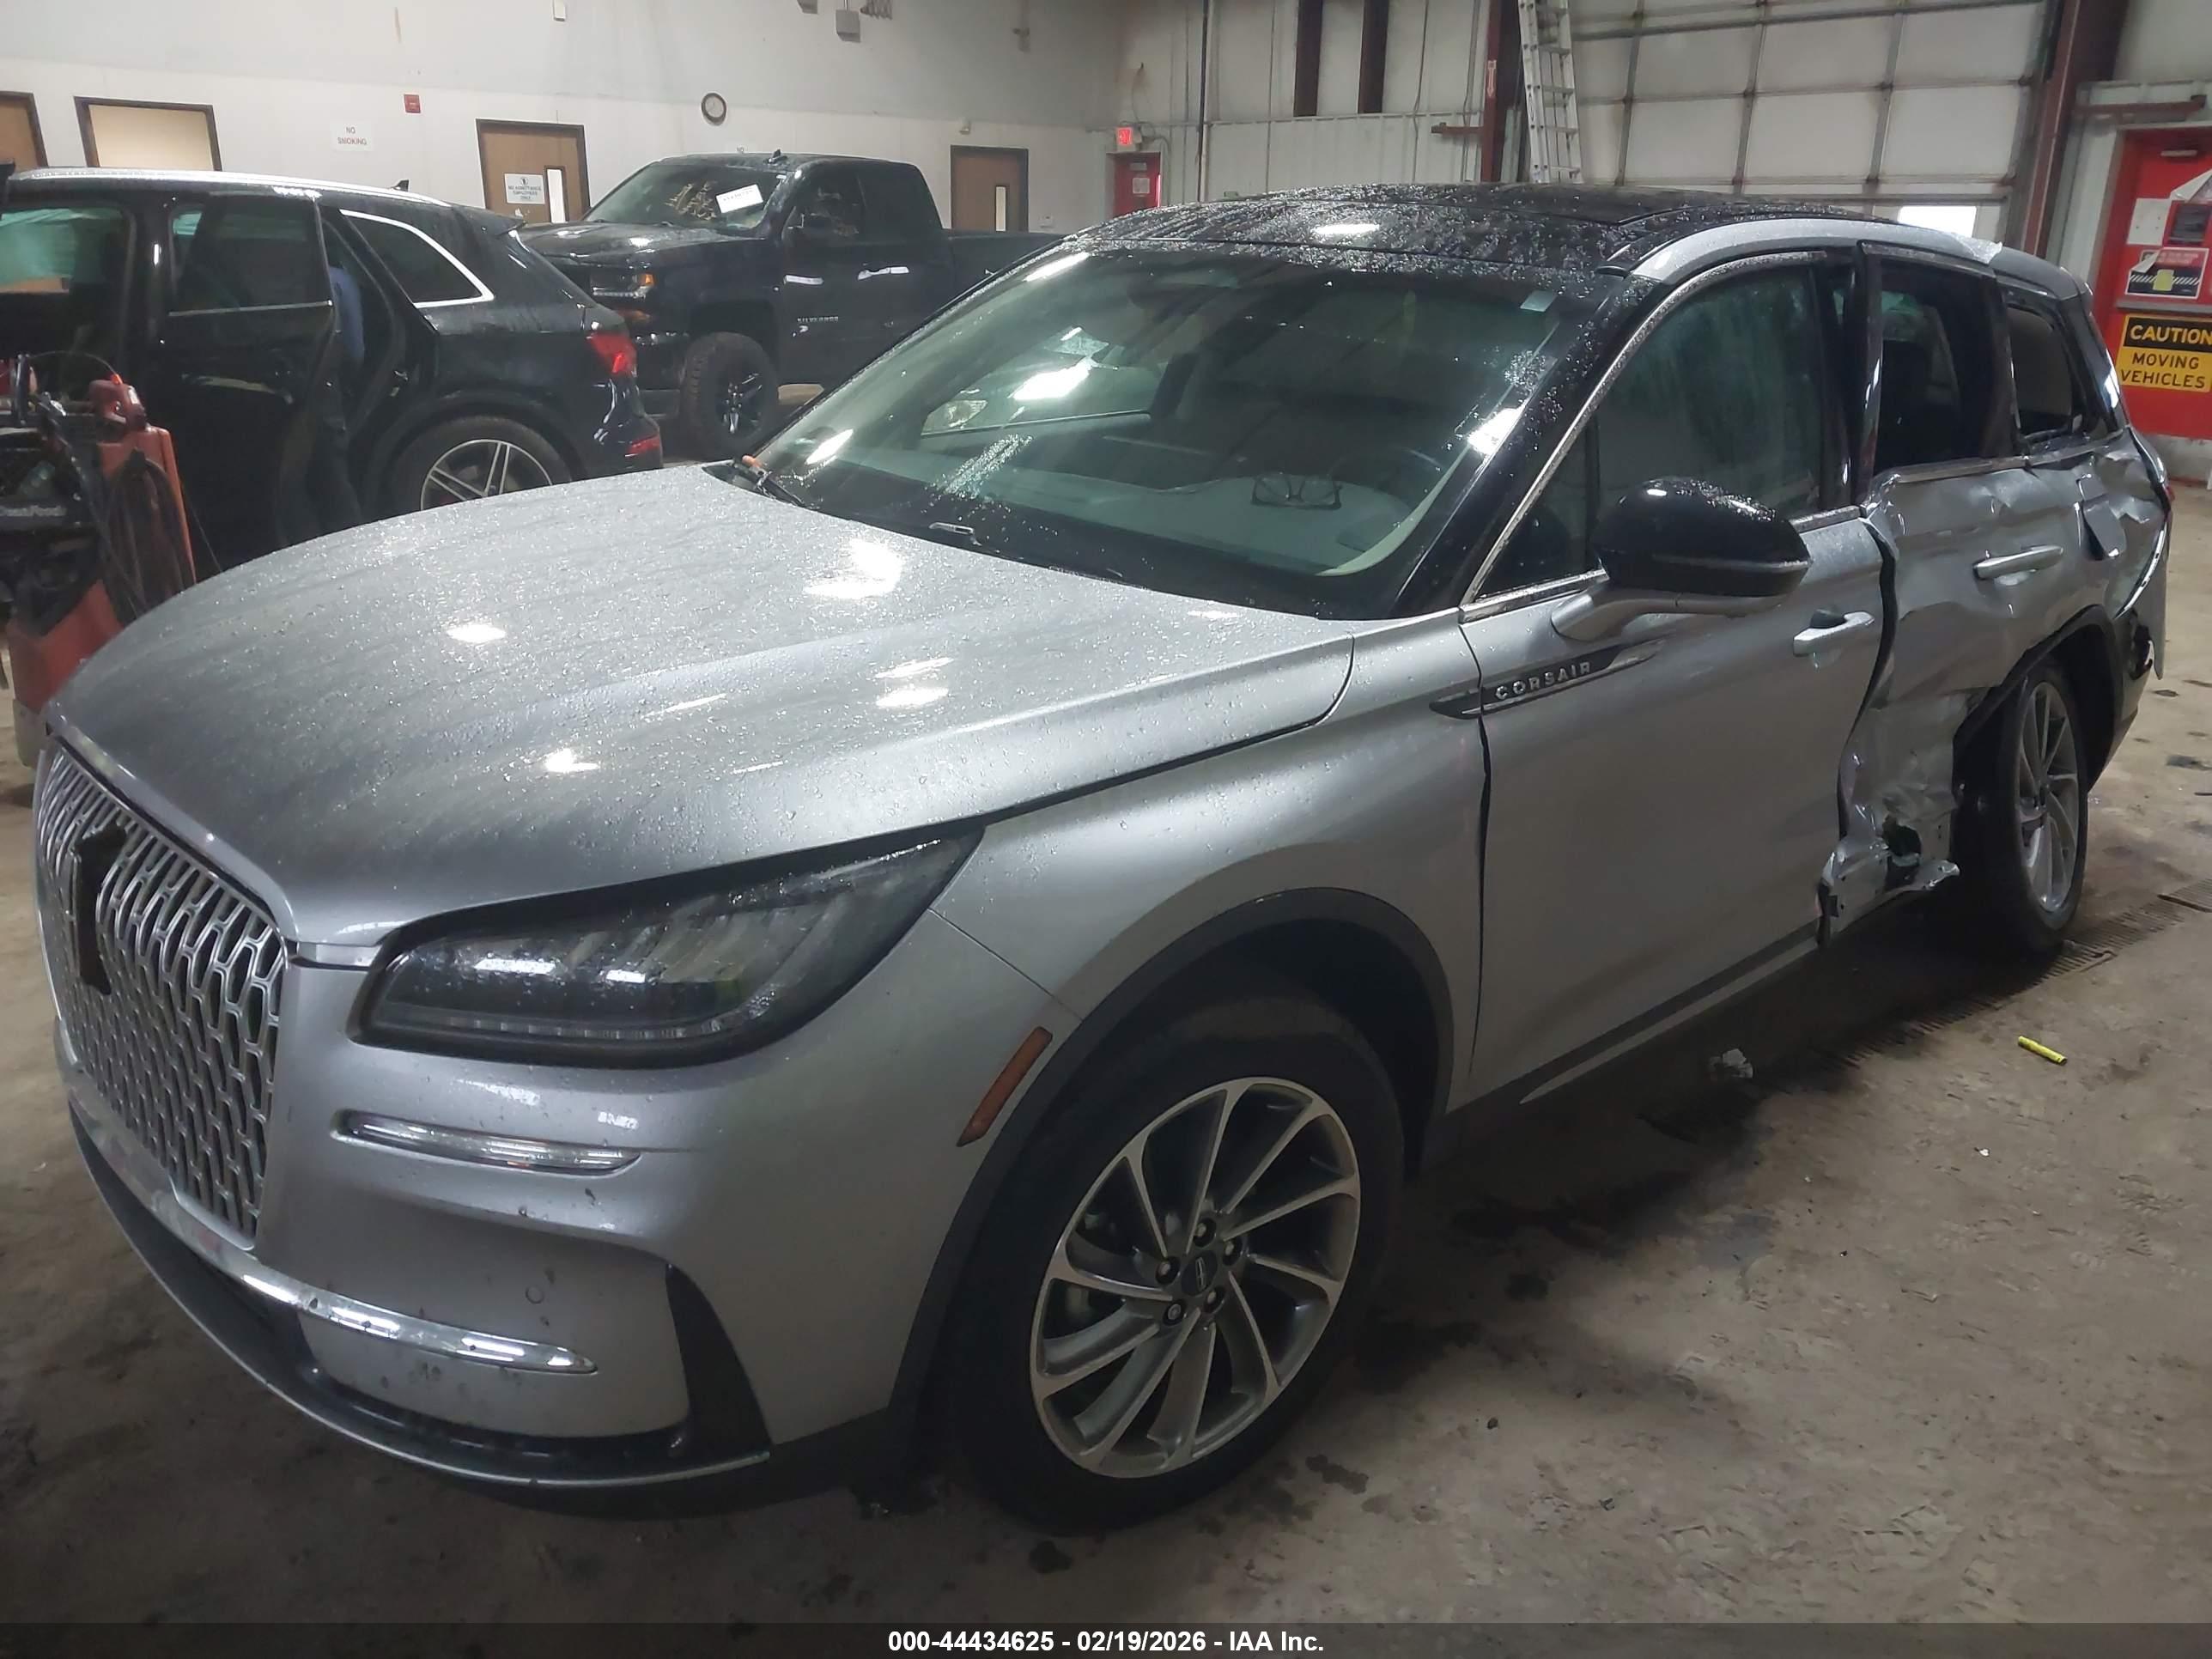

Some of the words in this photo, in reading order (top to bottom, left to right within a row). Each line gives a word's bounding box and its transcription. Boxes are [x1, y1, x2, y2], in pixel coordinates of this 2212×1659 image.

[337, 137, 368, 145] SMOKING
[2130, 324, 2212, 346] CAUTION
[2131, 352, 2200, 370] MOVING
[2120, 368, 2206, 389] VEHICLES
[1495, 661, 1590, 700] CORSAIR
